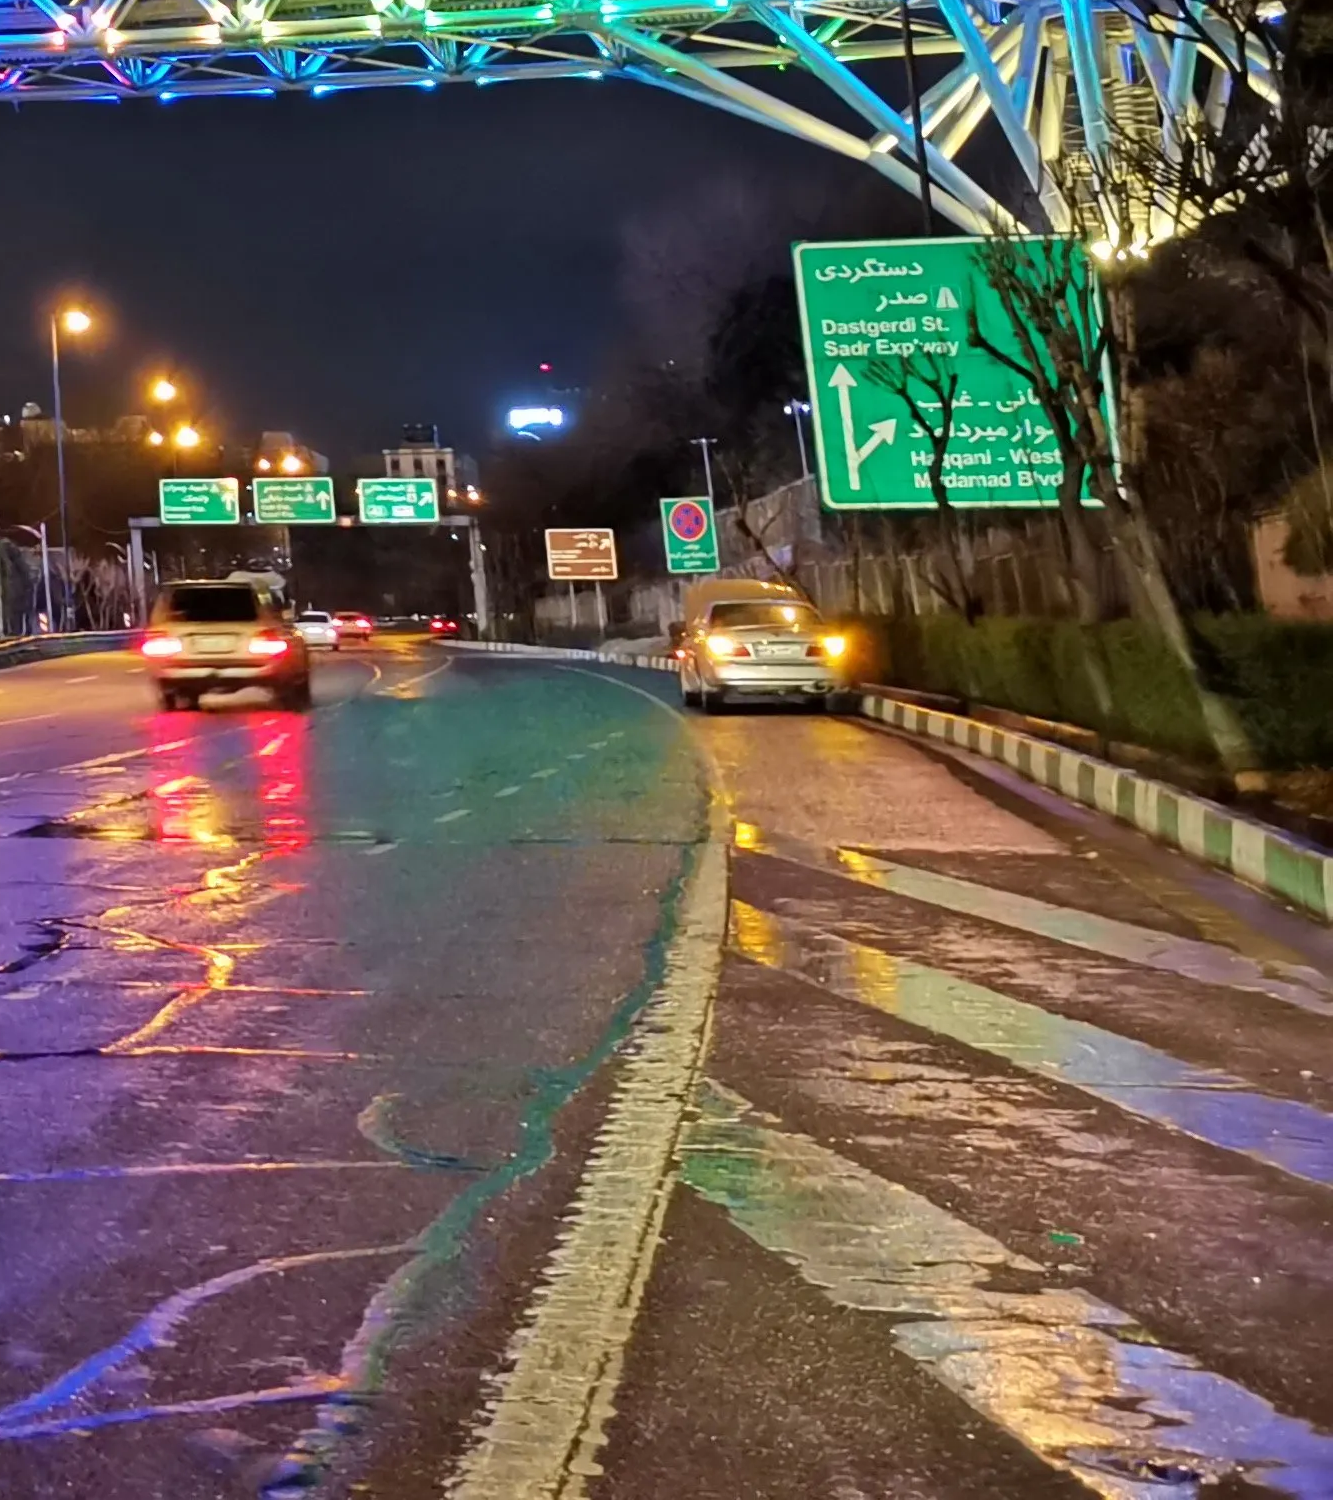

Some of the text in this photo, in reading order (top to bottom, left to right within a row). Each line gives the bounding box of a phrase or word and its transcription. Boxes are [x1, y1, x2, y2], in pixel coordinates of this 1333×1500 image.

[815, 258, 924, 284] دستگردی
[875, 291, 928, 312] صدر
[821, 316, 950, 338] Dastgerdi St.
[824, 340, 871, 357] Sadr
[1009, 448, 1063, 466] West
[913, 470, 1012, 489] Mdamad
